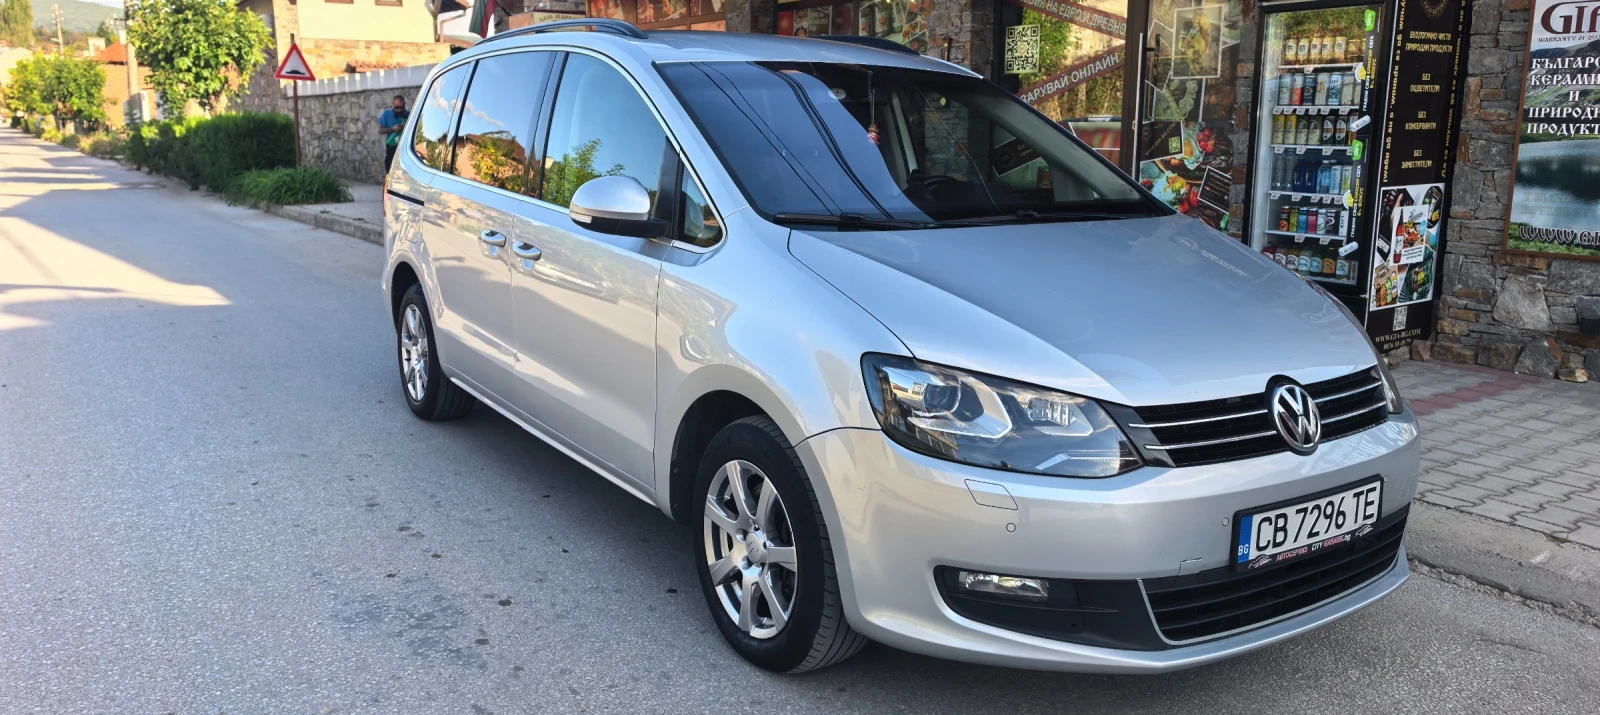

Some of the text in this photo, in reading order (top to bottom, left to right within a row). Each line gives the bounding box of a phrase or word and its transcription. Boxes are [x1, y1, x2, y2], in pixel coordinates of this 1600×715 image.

[1046, 1, 1058, 13] НА
[1060, 5, 1081, 20] ЕДРО
[1090, 14, 1127, 35] ДРЕБНО
[1070, 52, 1119, 83] ОНЛАЙН
[1568, 90, 1580, 102] И
[1413, 149, 1422, 157] БЕЗ
[1255, 486, 1377, 552] CB 7296 TE
[1238, 544, 1250, 556] BG
[1311, 541, 1324, 551] CITY
